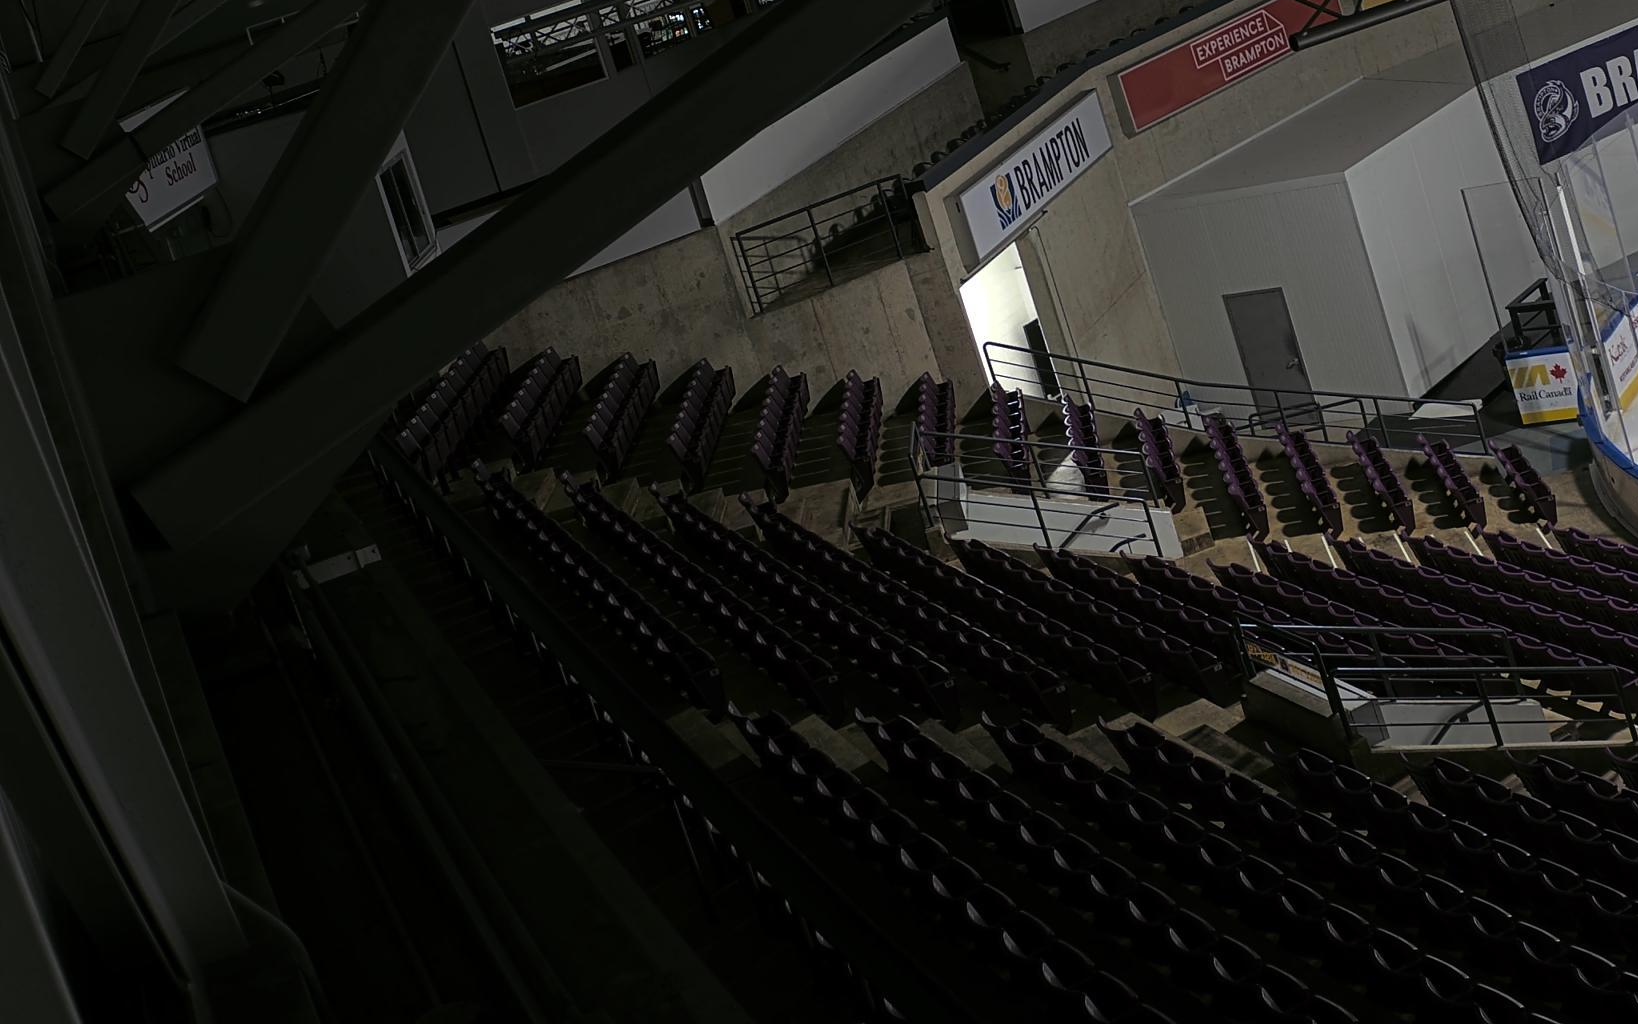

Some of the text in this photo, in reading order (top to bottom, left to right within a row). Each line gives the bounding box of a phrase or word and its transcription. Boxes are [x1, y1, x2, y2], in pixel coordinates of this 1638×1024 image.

[1196, 16, 1265, 61] EXPERIENCE
[1224, 33, 1285, 74] BRAMPTON
[165, 152, 197, 186] School
[1015, 118, 1090, 211] BRAMPTON
[1519, 391, 1538, 402] Rail
